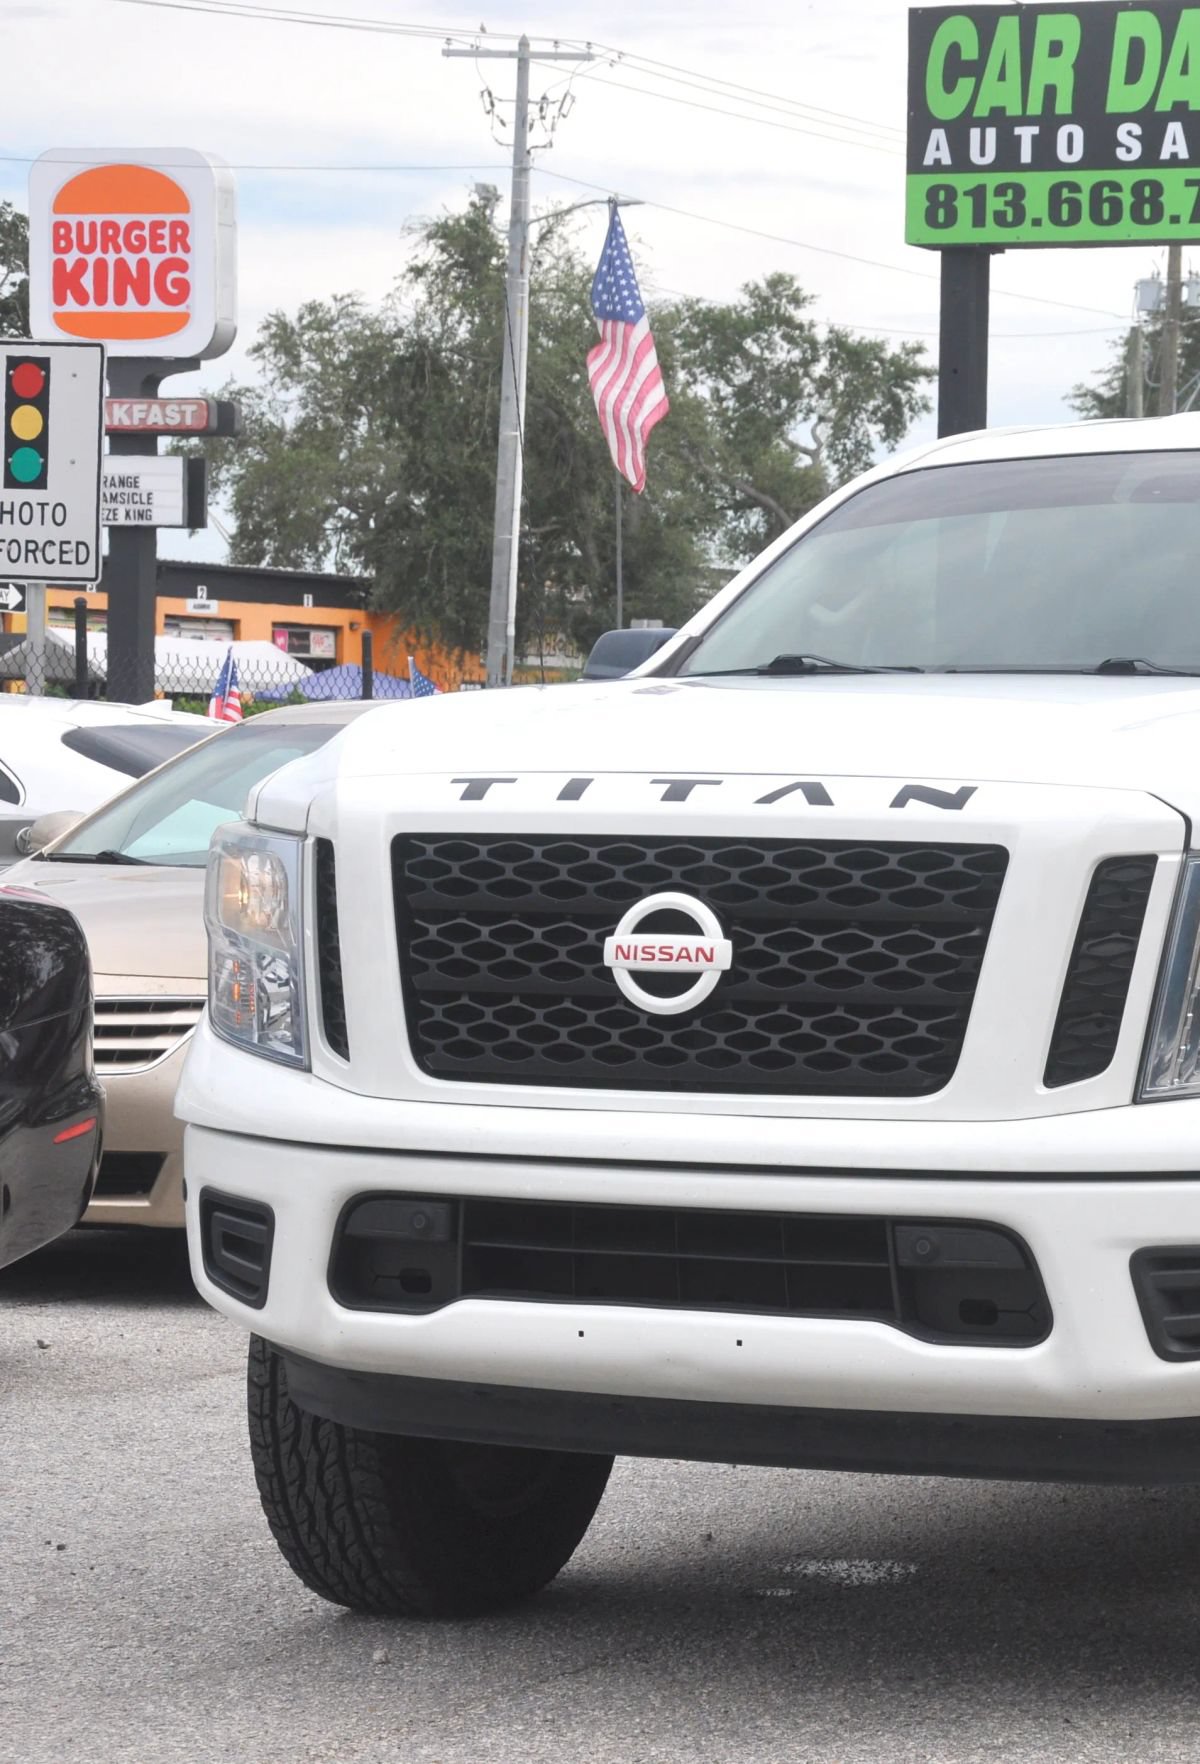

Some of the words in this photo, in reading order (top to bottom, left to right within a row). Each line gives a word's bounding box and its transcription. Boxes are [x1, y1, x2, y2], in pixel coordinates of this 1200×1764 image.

[925, 13, 1081, 120] CAR
[922, 124, 1084, 166] AUTO
[53, 220, 191, 254] BURGER
[53, 257, 191, 306] KING
[105, 403, 198, 426] KFAST
[0, 501, 67, 527] HOTO
[125, 508, 152, 521] KING
[450, 778, 978, 810] TITAN
[615, 944, 714, 963] NISSAN
